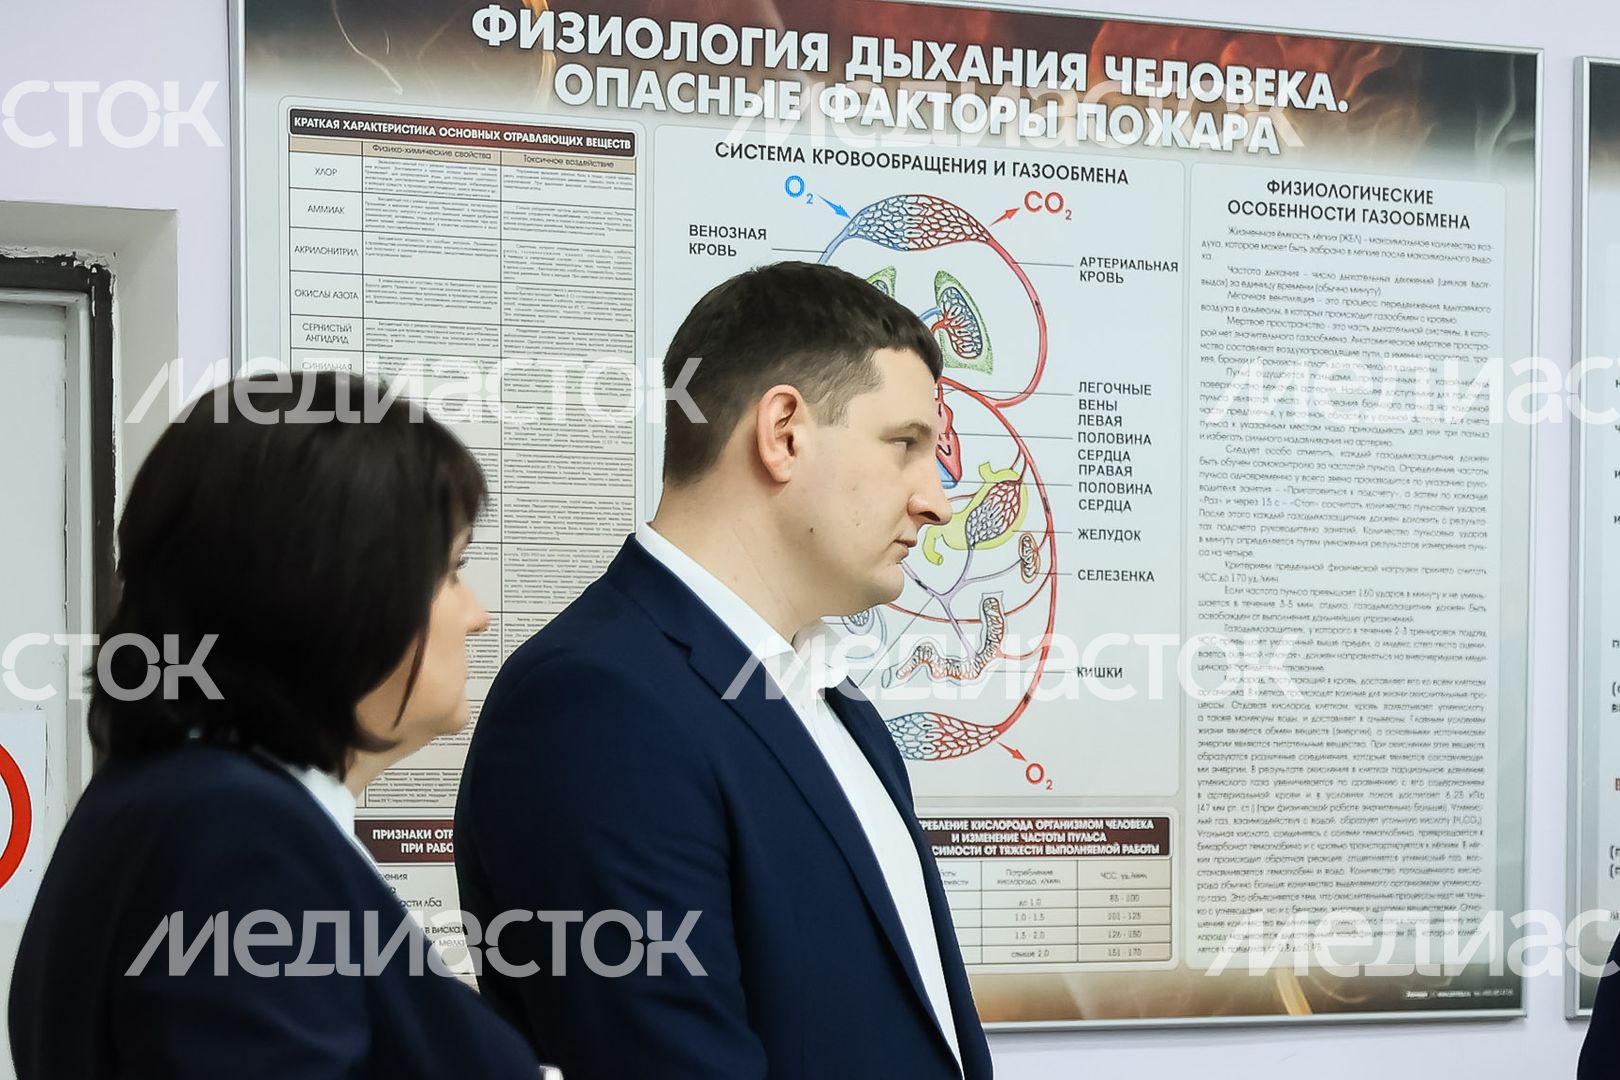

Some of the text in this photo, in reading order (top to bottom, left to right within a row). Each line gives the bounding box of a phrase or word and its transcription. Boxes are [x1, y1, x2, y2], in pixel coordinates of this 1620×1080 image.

[471, 4, 1350, 113] ФИЗИОЛОГИЯ ДЫХАНИЯ ЧЕЛОВЕКА.
[554, 63, 1281, 155] ОПАСНЫЕ ФАКТОРЫ ПОЖАРА
[293, 116, 632, 151] КРАТКАЯ ХАРАКТЕРИСТИКА ОСНОВНЫХ ОТРАВЛЯЮЩИХ ВЕЩЕСТВ
[714, 141, 1129, 185] СИСТЕМА КРОВООБРАЩЕНИЯ И ГАЗООБМЕНА
[313, 167, 338, 177] ХЛОР
[1266, 179, 1434, 205] ФИЗИОЛОГИЧЕСКИЕ
[306, 204, 345, 214] АММИАК
[1226, 199, 1471, 230] ОСОБЕННОСТИ ГАЗООБМЕНА
[688, 224, 767, 240] ВЕНОЗНАЯ
[688, 242, 737, 257] КРОВЬ
[1079, 257, 1179, 272] АРТЕРИАЛЬНАЯ
[1079, 271, 1124, 284] КРОВЬ
[294, 289, 360, 301] ОКИСЛЫ АЗОТА
[302, 323, 352, 333] СЕРНИСТЫЙ
[305, 334, 349, 344] АНГИДРИД
[1077, 381, 1152, 396] ЛЕГОЧНЫЕ
[1077, 398, 1118, 411] ВЕНЫ
[1076, 413, 1123, 427] ЛЕВАЯ
[1076, 431, 1152, 445] ПОЛОВИНА
[1077, 449, 1131, 463] СЕРДЦА
[1077, 464, 1133, 477] ПРАВАЯ
[1077, 481, 1153, 495] ПОЛОВИНА
[1077, 498, 1132, 513] СЕРДЦА
[1076, 528, 1142, 543] ЖЕЛУДОК
[1076, 568, 1155, 582] СЕЛЕЗЕНКА
[1076, 666, 1123, 678] КИШКИ
[372, 828, 432, 840] ПРИЗНАКИ
[400, 843, 423, 853] ПРИ
